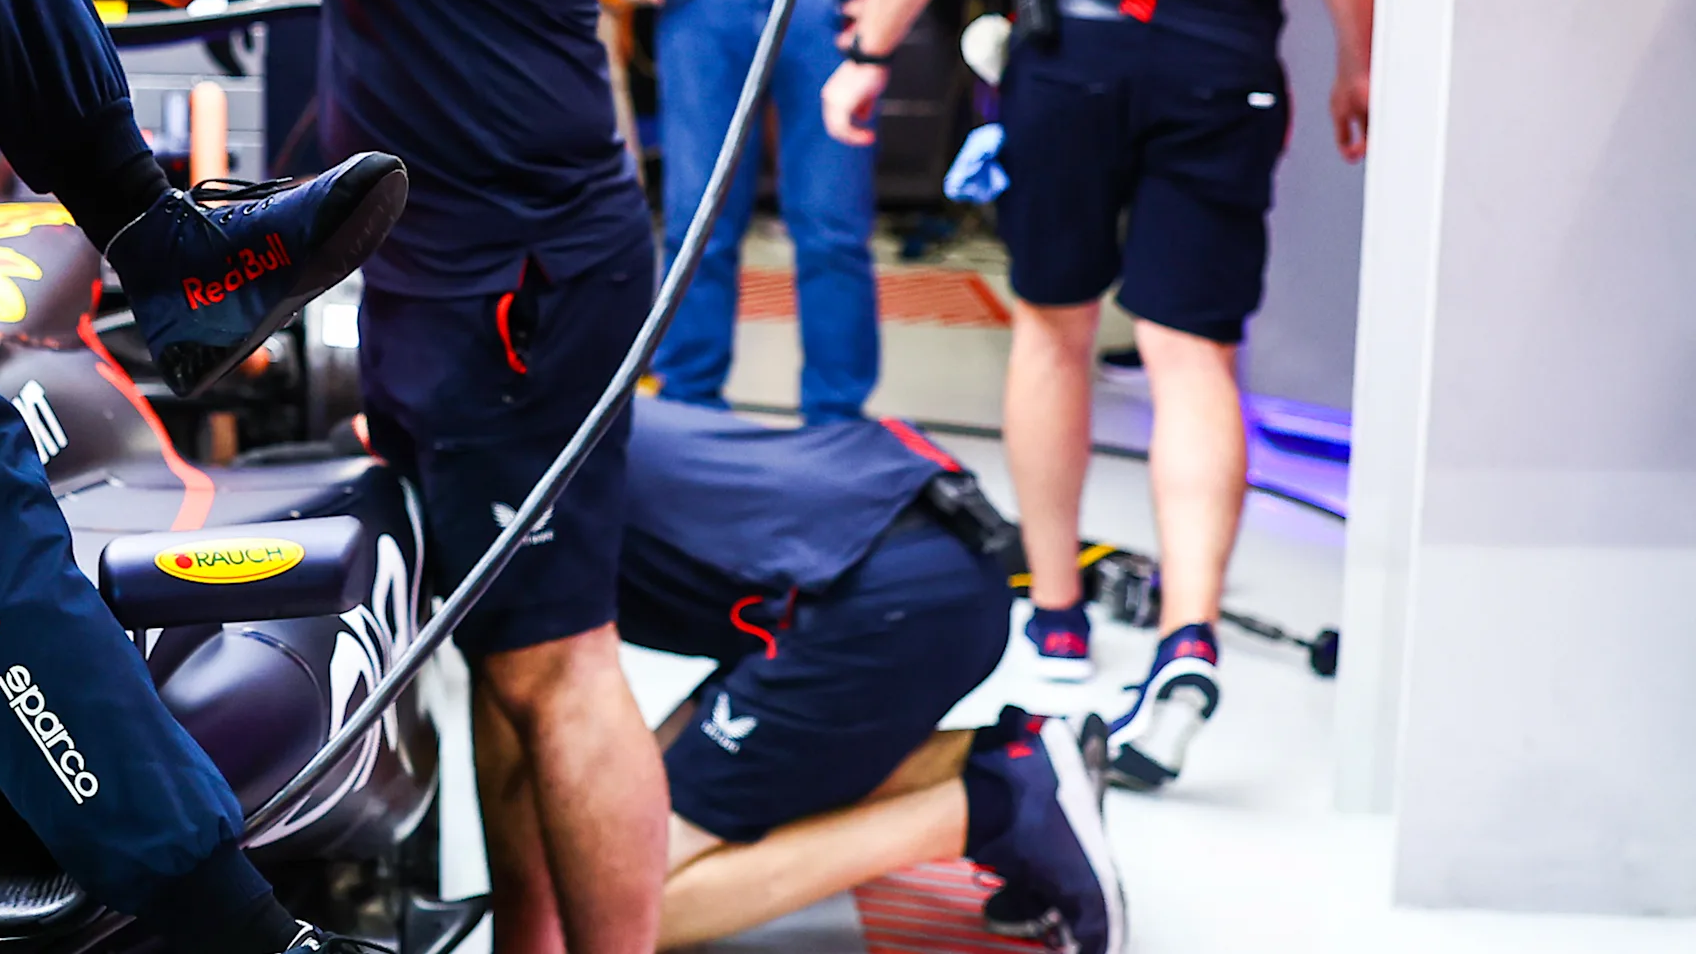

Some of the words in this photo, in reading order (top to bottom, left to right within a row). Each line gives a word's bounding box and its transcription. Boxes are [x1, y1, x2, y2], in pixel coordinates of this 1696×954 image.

[181, 256, 245, 311] Red
[238, 232, 292, 281] Bull
[194, 546, 284, 567] RAUCH
